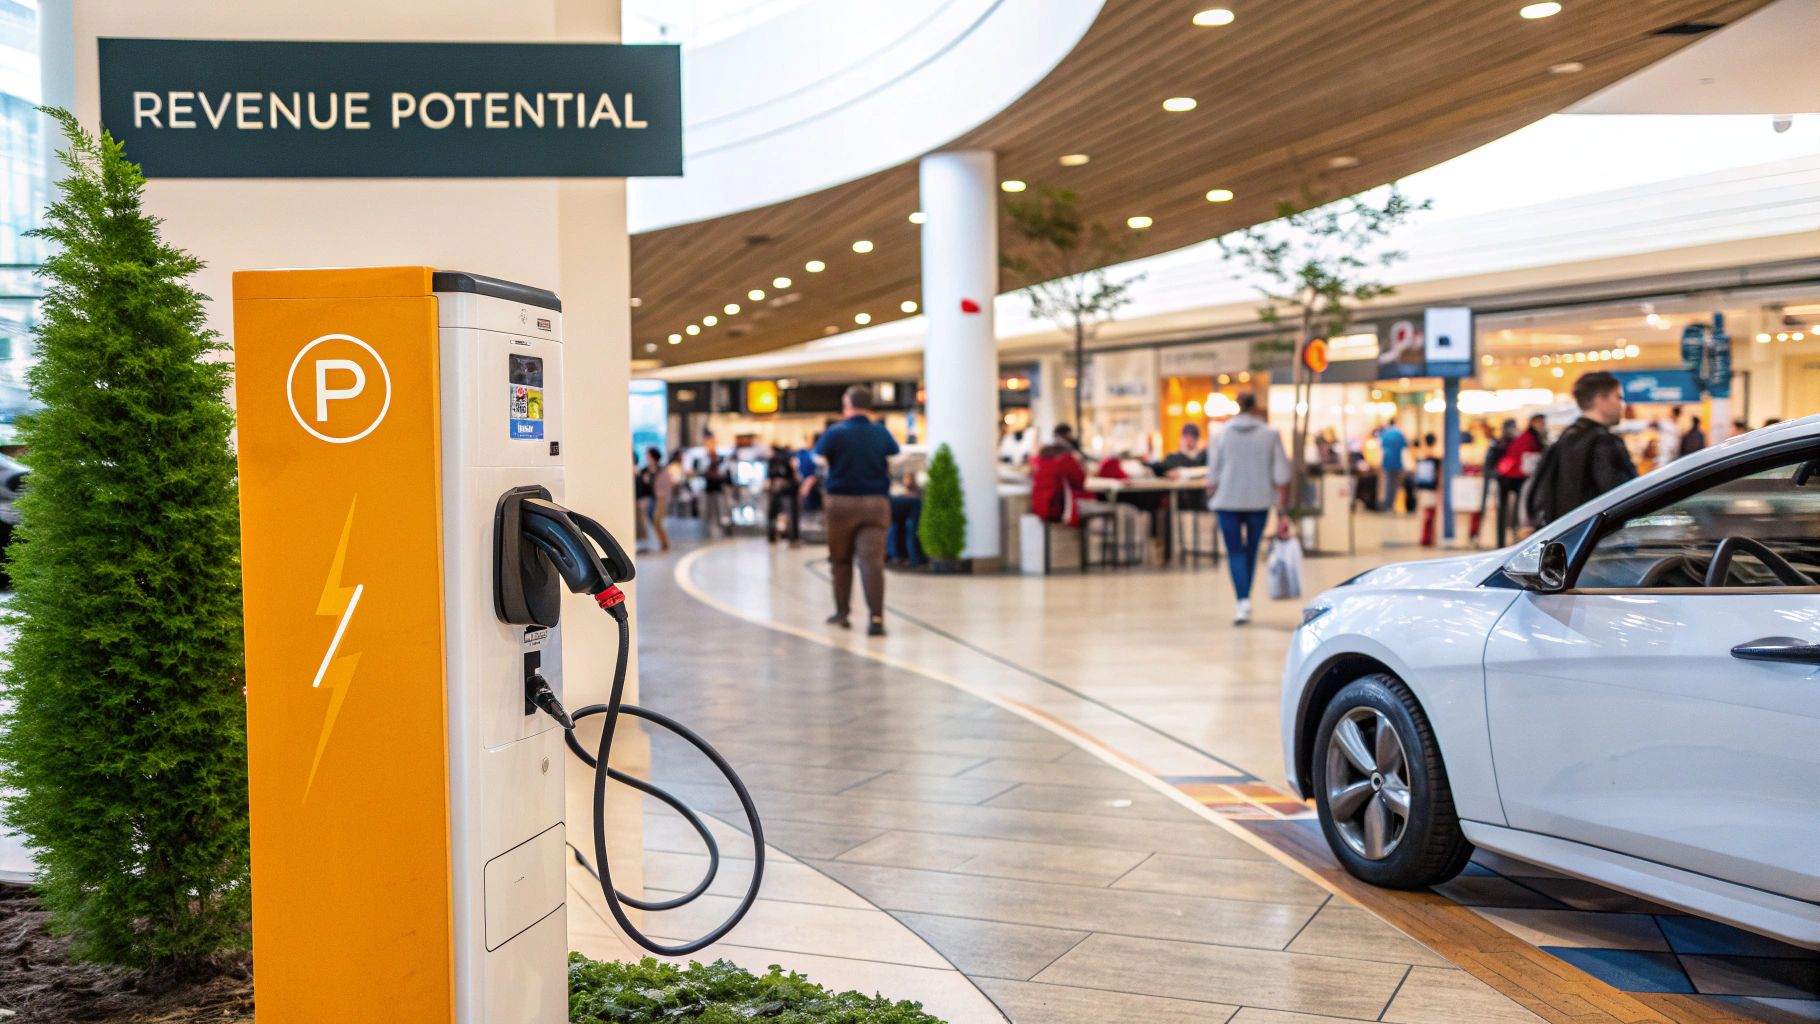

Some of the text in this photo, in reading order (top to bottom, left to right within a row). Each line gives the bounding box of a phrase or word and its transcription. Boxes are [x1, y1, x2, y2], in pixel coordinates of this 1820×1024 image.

[133, 91, 649, 129] REVENUE POTENTIAL
[316, 359, 366, 422] P
